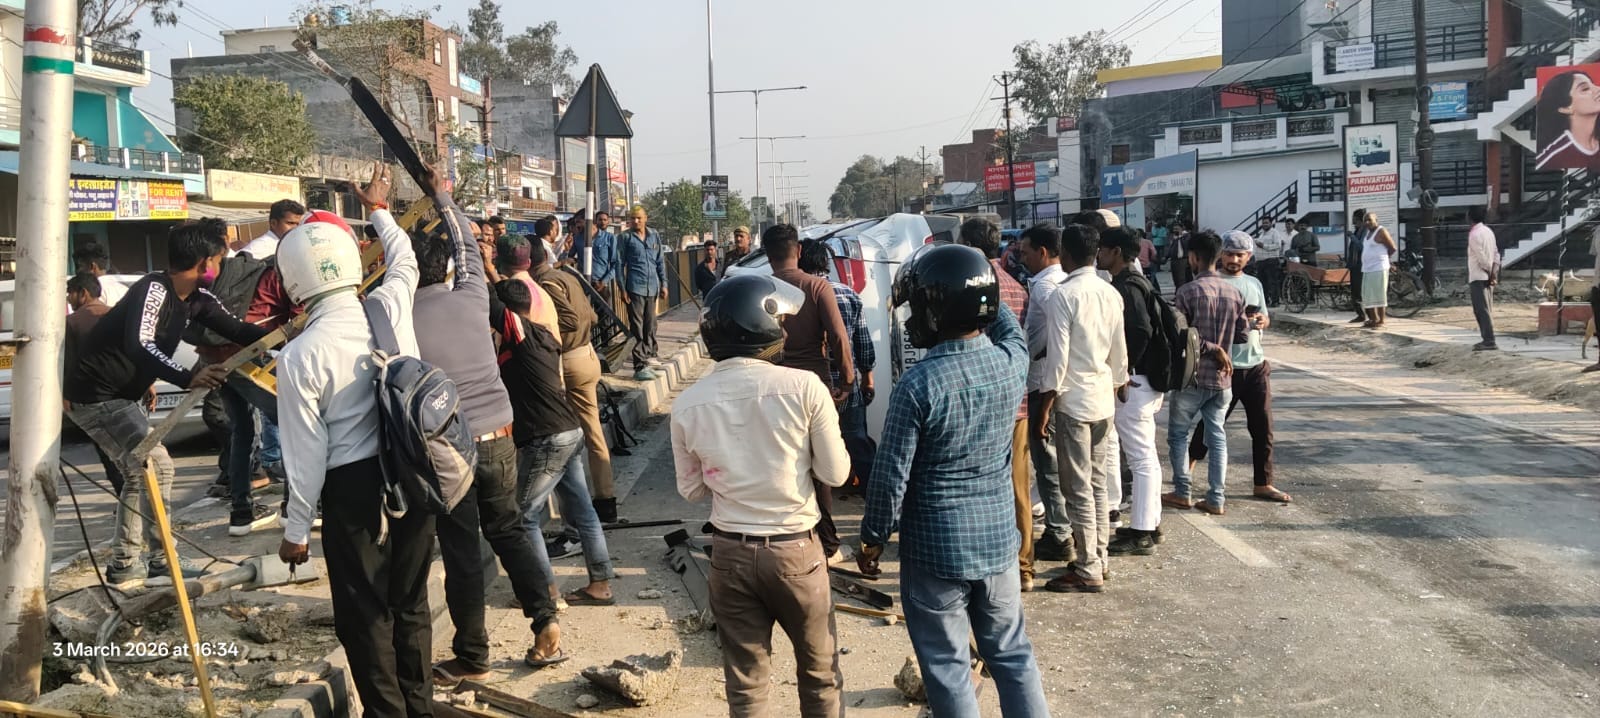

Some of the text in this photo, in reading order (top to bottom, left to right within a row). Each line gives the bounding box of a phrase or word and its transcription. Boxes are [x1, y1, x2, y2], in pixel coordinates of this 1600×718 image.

[1350, 175, 1395, 185] PARIVARTAN
[150, 187, 183, 197] FOR RENT
[1350, 183, 1396, 193] AUTOMATION
